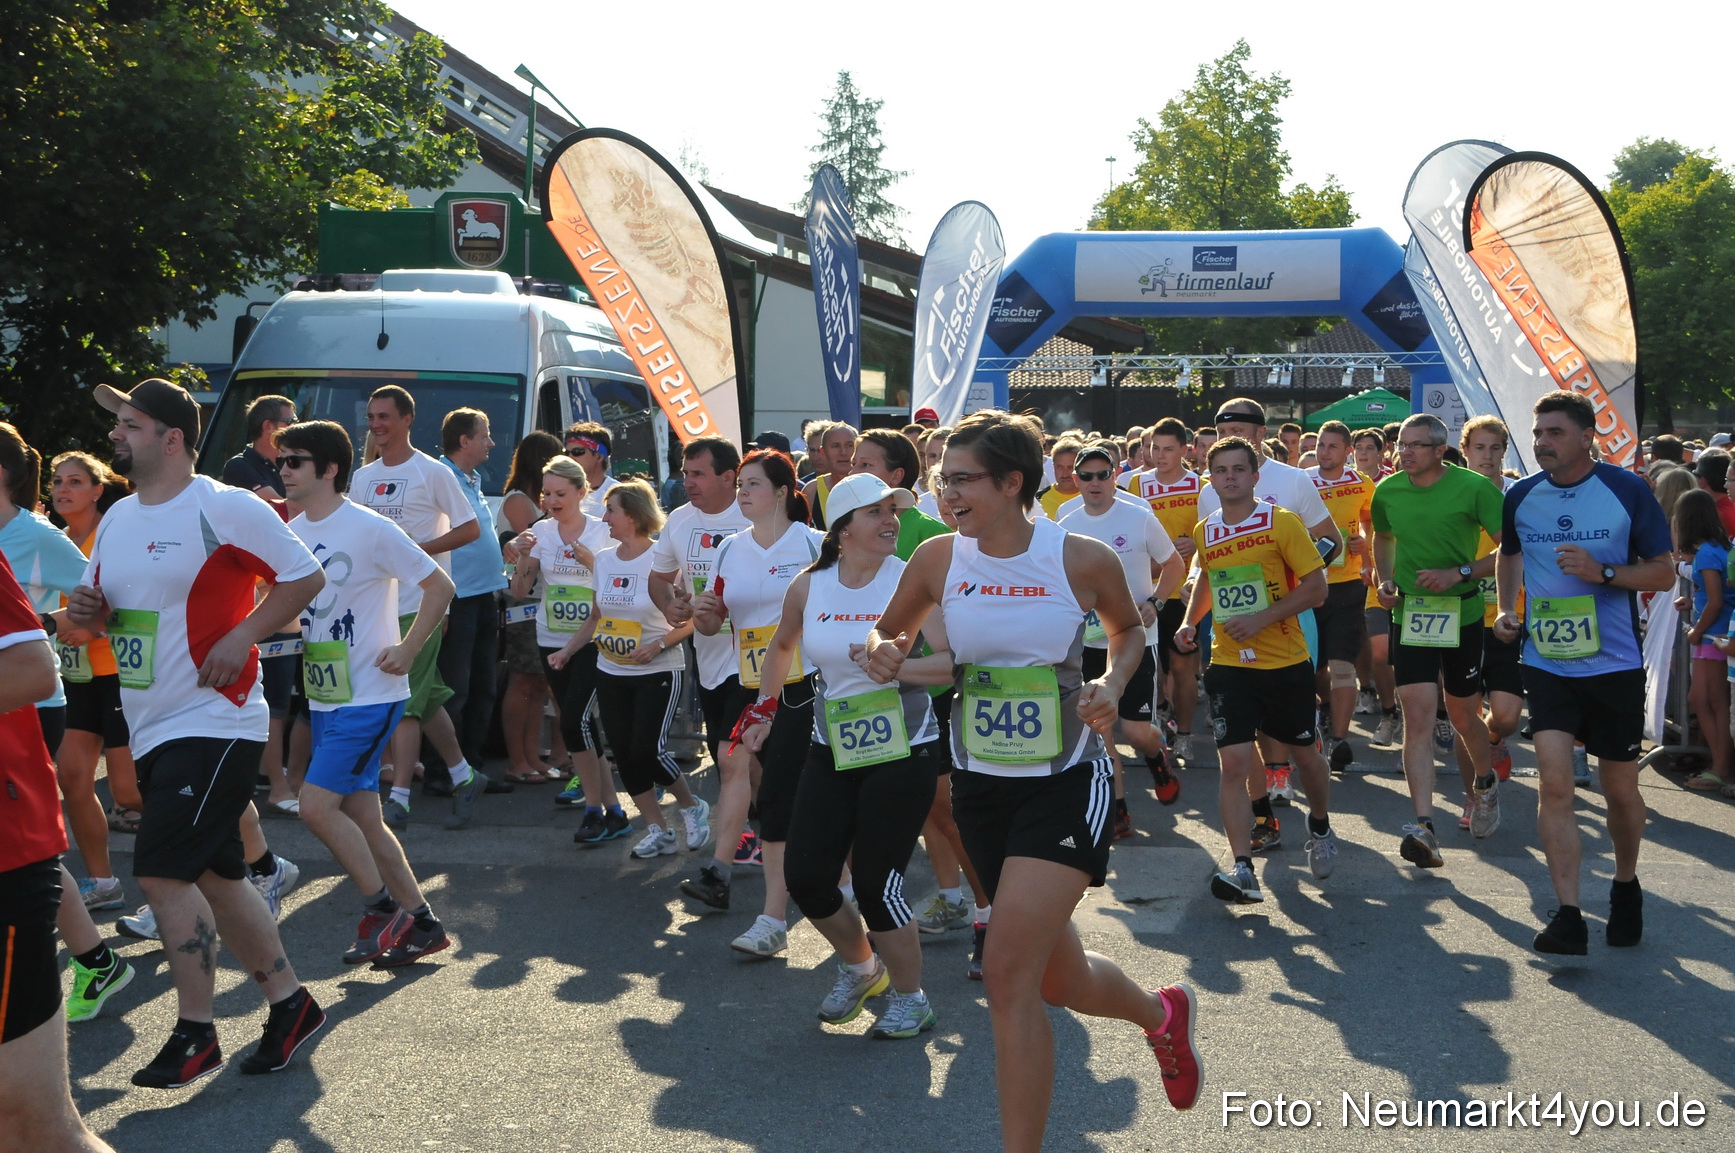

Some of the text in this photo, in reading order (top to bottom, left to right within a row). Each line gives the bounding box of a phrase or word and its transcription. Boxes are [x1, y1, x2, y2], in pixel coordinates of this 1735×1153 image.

[467, 251, 492, 262] 1628
[1201, 255, 1234, 264] Fischer
[1176, 271, 1275, 290] firmenlauf
[940, 231, 986, 364] Fischer
[956, 255, 992, 361] AUTOMOBILE
[990, 306, 1042, 317] Fischer
[1336, 486, 1366, 498] BÖGL
[1151, 501, 1166, 511] AX
[1525, 528, 1610, 543] SCHABMÜLLER
[1205, 534, 1275, 563] MAX BÖGL
[686, 562, 711, 571] POL
[600, 595, 634, 603] POLGER
[980, 585, 1052, 597] KLEBL
[1217, 584, 1258, 609] 829
[552, 601, 591, 621] 999
[1410, 613, 1451, 634] 577
[1531, 617, 1593, 643] 1231
[304, 661, 338, 688] 301
[974, 699, 1042, 739] 548
[839, 715, 892, 750] 529
